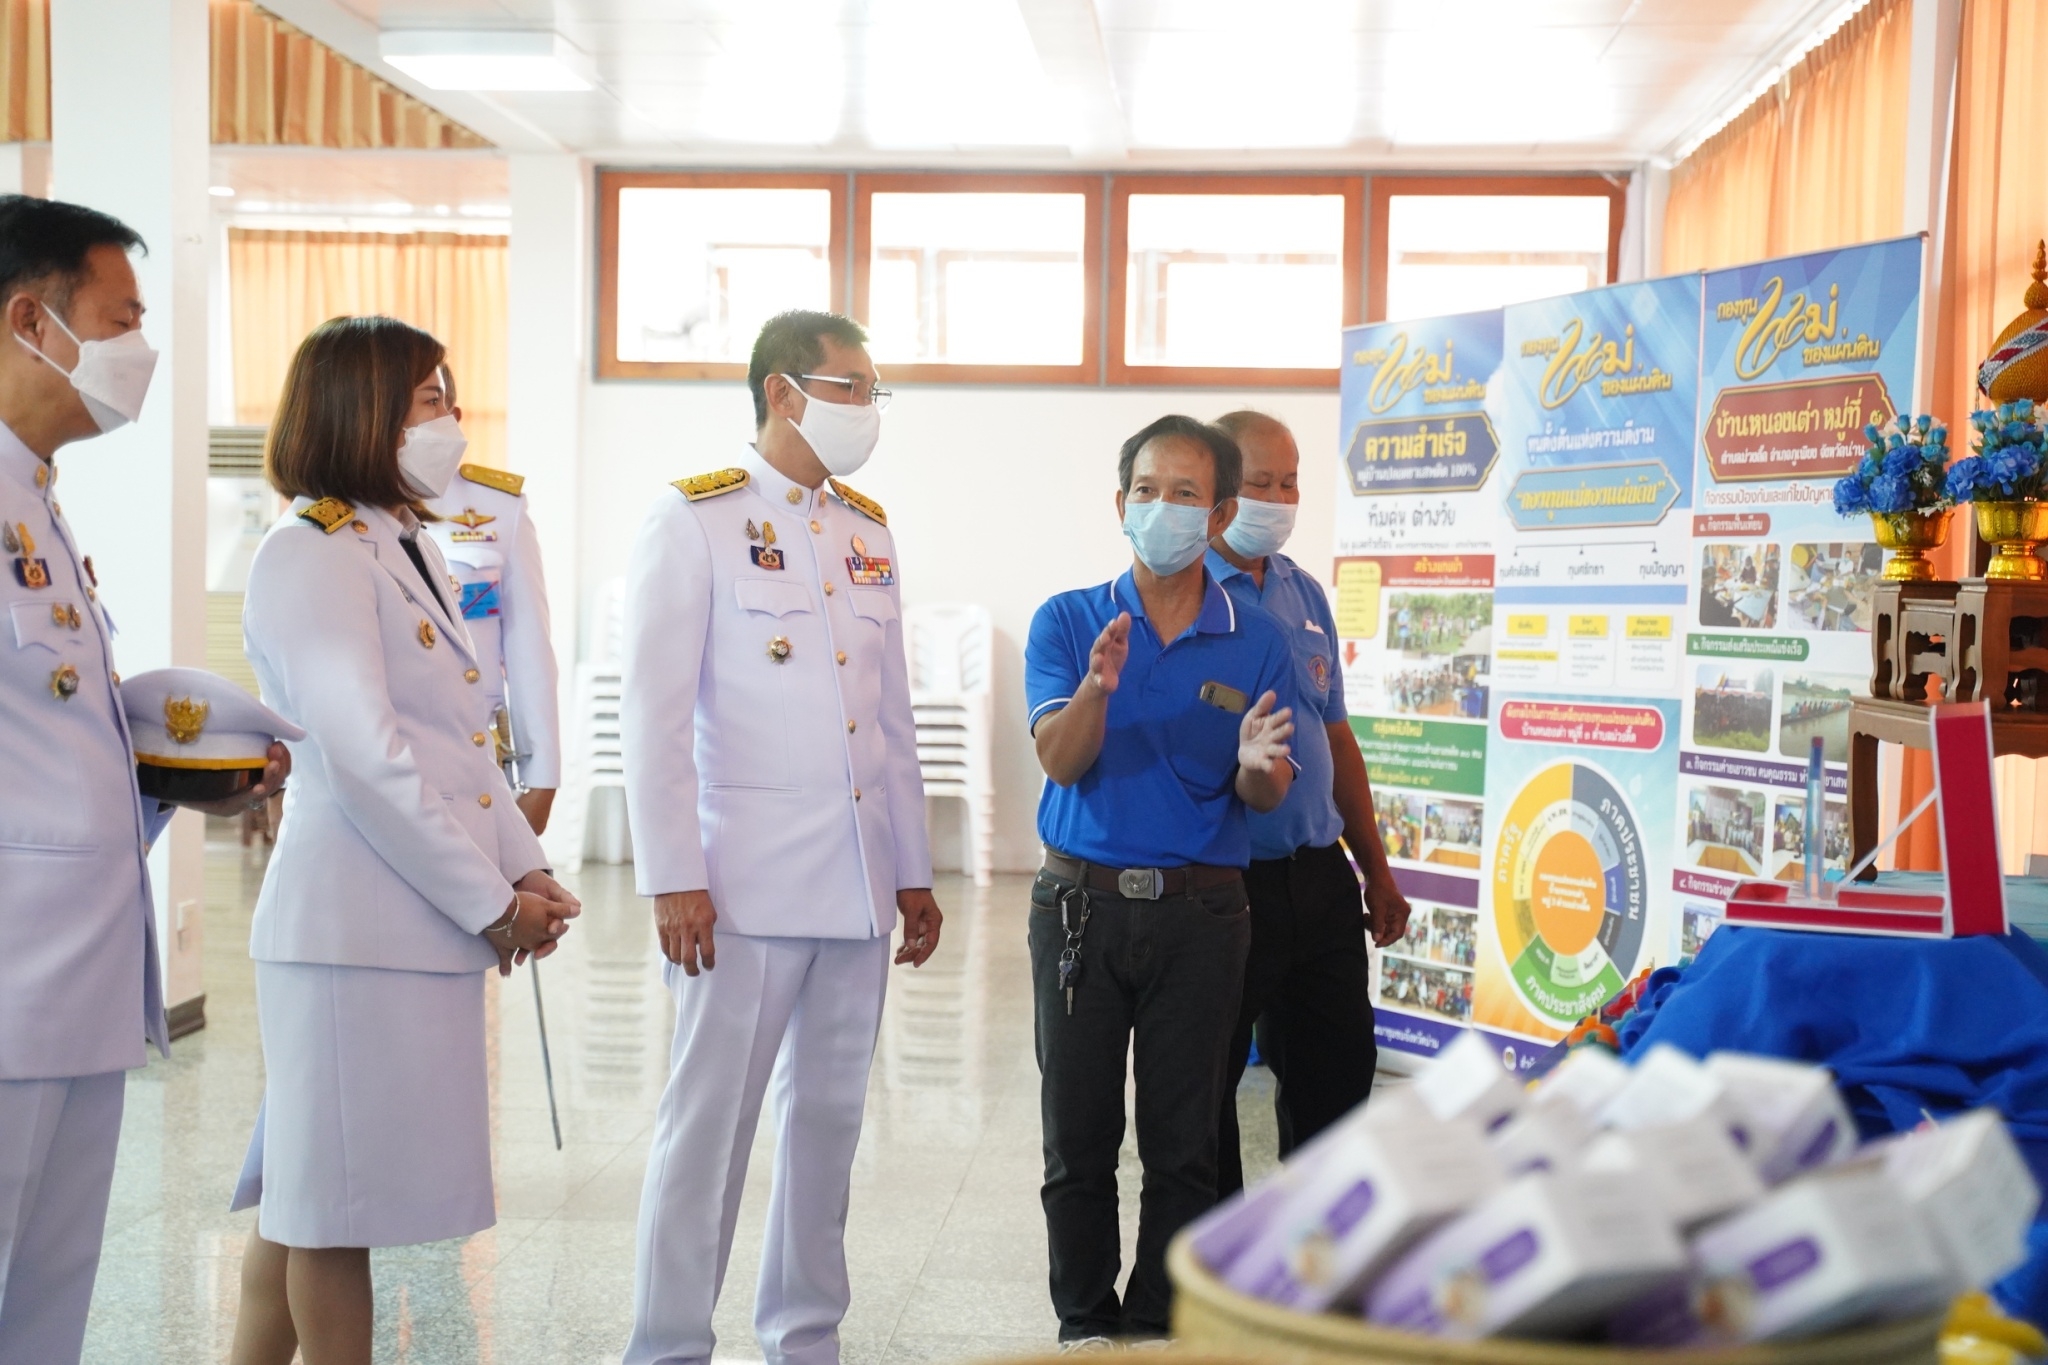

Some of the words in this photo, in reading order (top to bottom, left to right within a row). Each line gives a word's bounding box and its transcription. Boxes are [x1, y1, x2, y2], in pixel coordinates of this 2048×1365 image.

[1717, 297, 1758, 325] กองทุน
[1803, 327, 1880, 367] ของแผ่นดิน
[1601, 362, 1673, 398] ของแผ่นดิน
[1716, 399, 1820, 438] บ้านหนองเต่า
[1823, 387, 1863, 441] หมู่ที่
[1365, 420, 1468, 462] ความสำเร็จ
[1639, 560, 1685, 579] ทุนปัญญา
[1600, 797, 1641, 921] ภาคประชาชน
